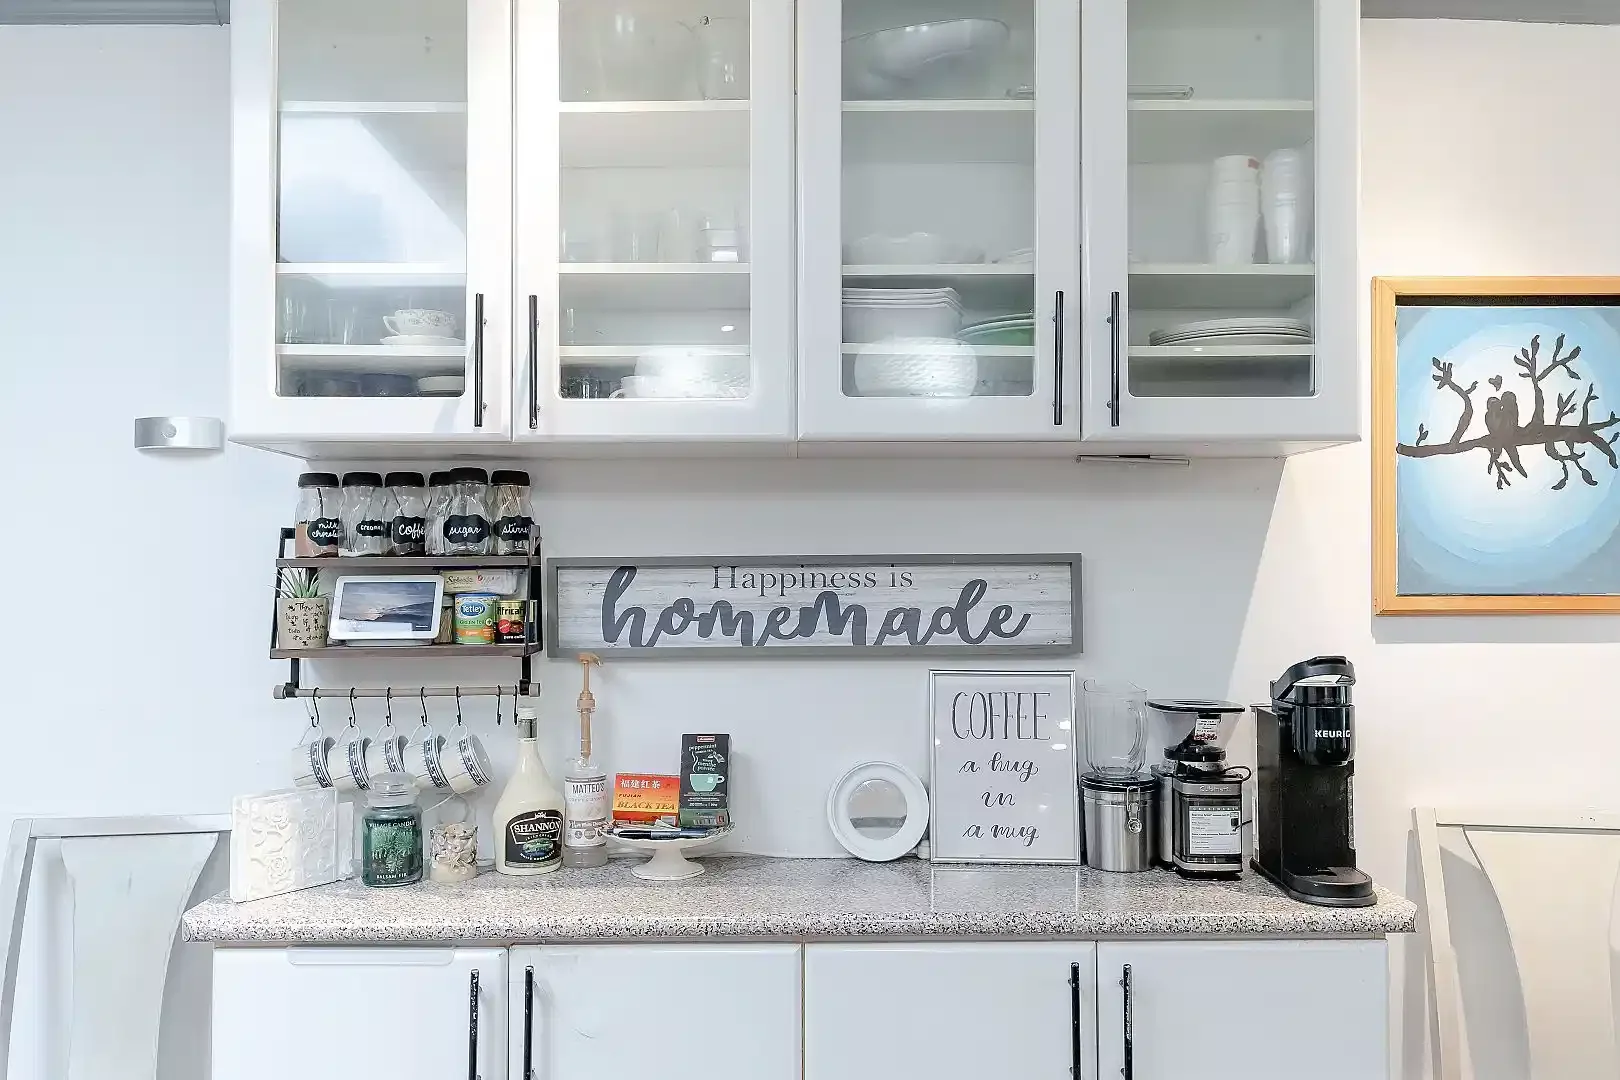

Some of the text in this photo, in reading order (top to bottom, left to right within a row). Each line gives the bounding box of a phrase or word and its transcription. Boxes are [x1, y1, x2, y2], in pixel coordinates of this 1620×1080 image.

[398, 523, 425, 539] Coffe
[448, 524, 482, 537] sugar
[712, 563, 913, 597] Happiness is
[460, 601, 484, 614] Tetley
[602, 565, 1032, 647] homemade
[952, 691, 1051, 741] COFFEE
[1314, 730, 1351, 738] KEURIG
[958, 752, 1039, 783] a hug
[572, 782, 605, 794] MATTEO'S
[620, 778, 661, 789] 福建红茶
[981, 785, 1016, 808] in
[616, 801, 676, 810] BLACK TEA
[513, 819, 561, 833] SHANNON
[962, 824, 1040, 847] a mug
